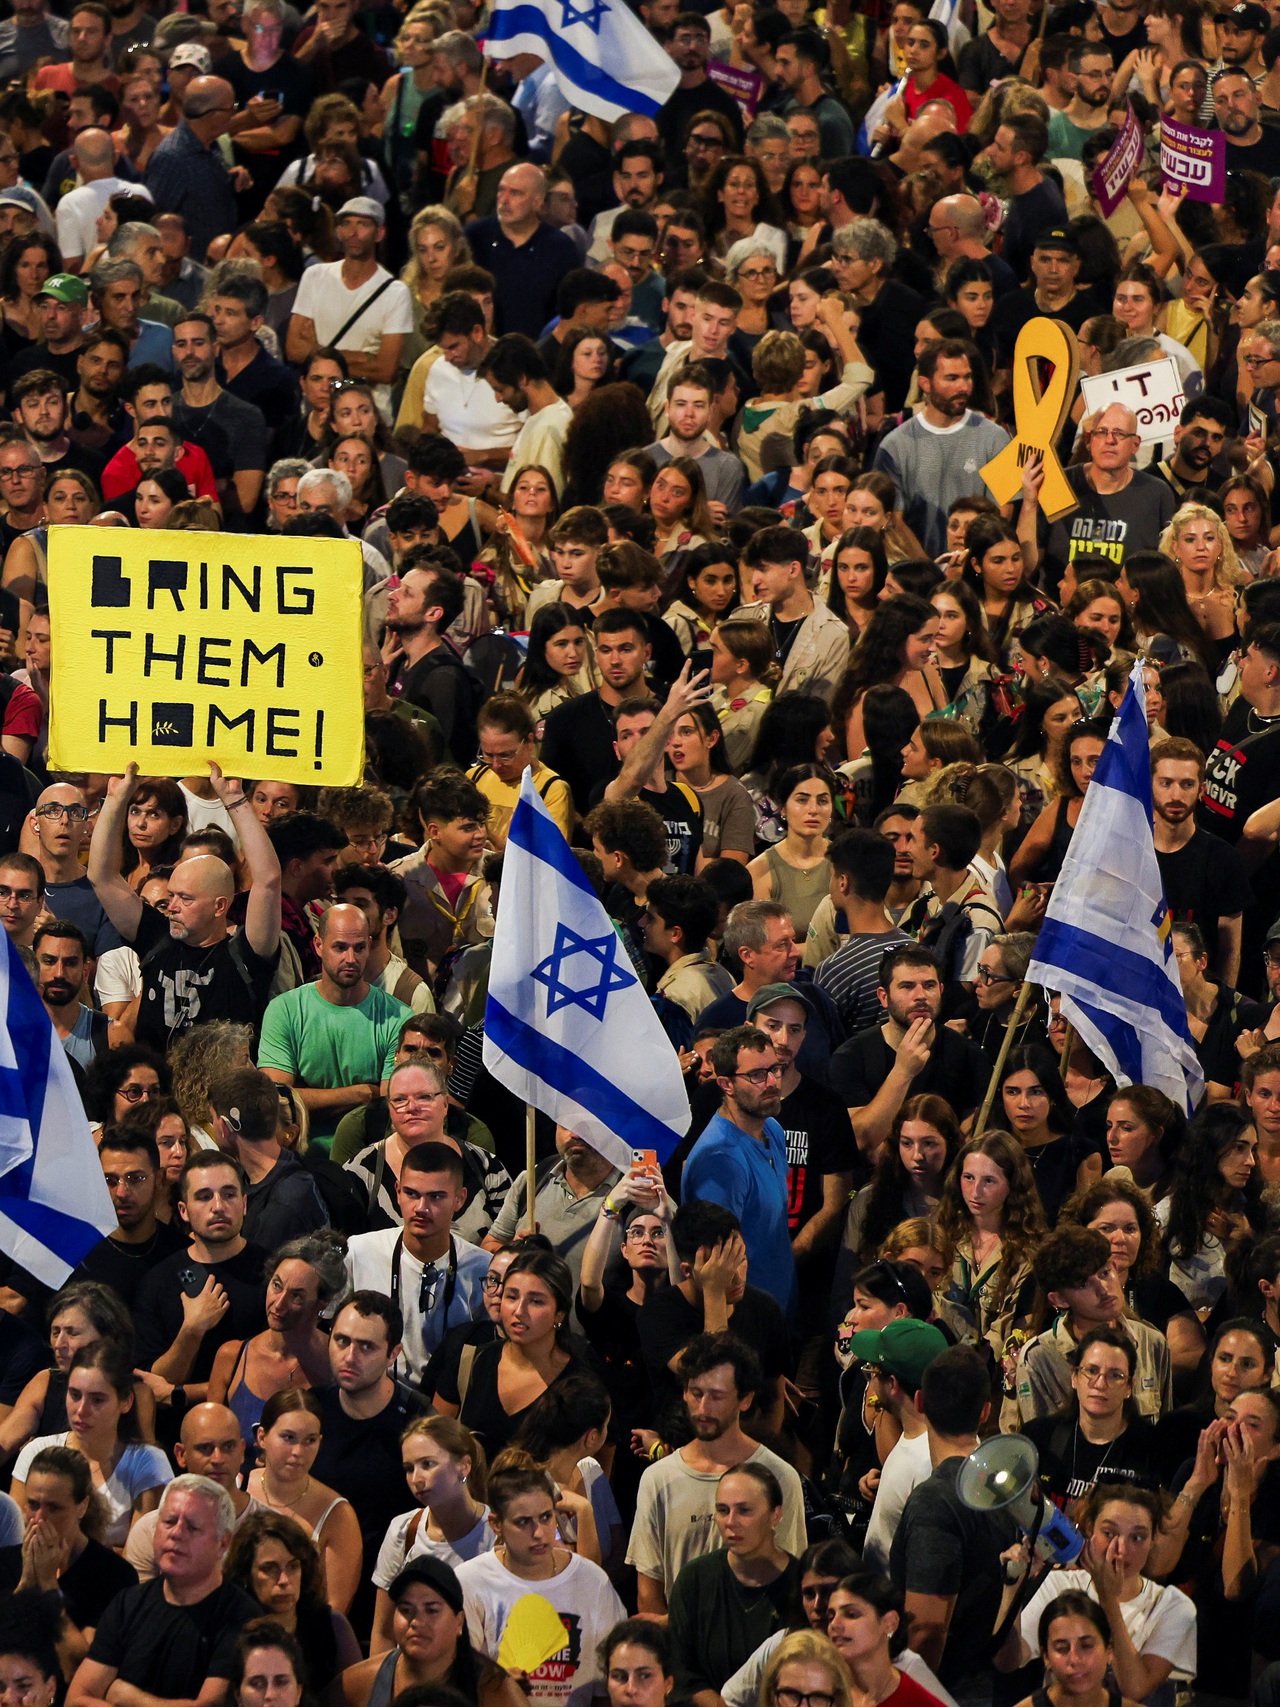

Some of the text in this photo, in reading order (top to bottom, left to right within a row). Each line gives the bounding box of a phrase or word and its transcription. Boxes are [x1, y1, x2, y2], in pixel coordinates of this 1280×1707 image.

[1189, 133, 1214, 149] לקבל
[1071, 518, 1094, 539] הם
[1069, 539, 1124, 565] עדיין
[90, 555, 315, 616] BRING
[90, 628, 287, 689] THEM
[1205, 747, 1242, 789] FCK
